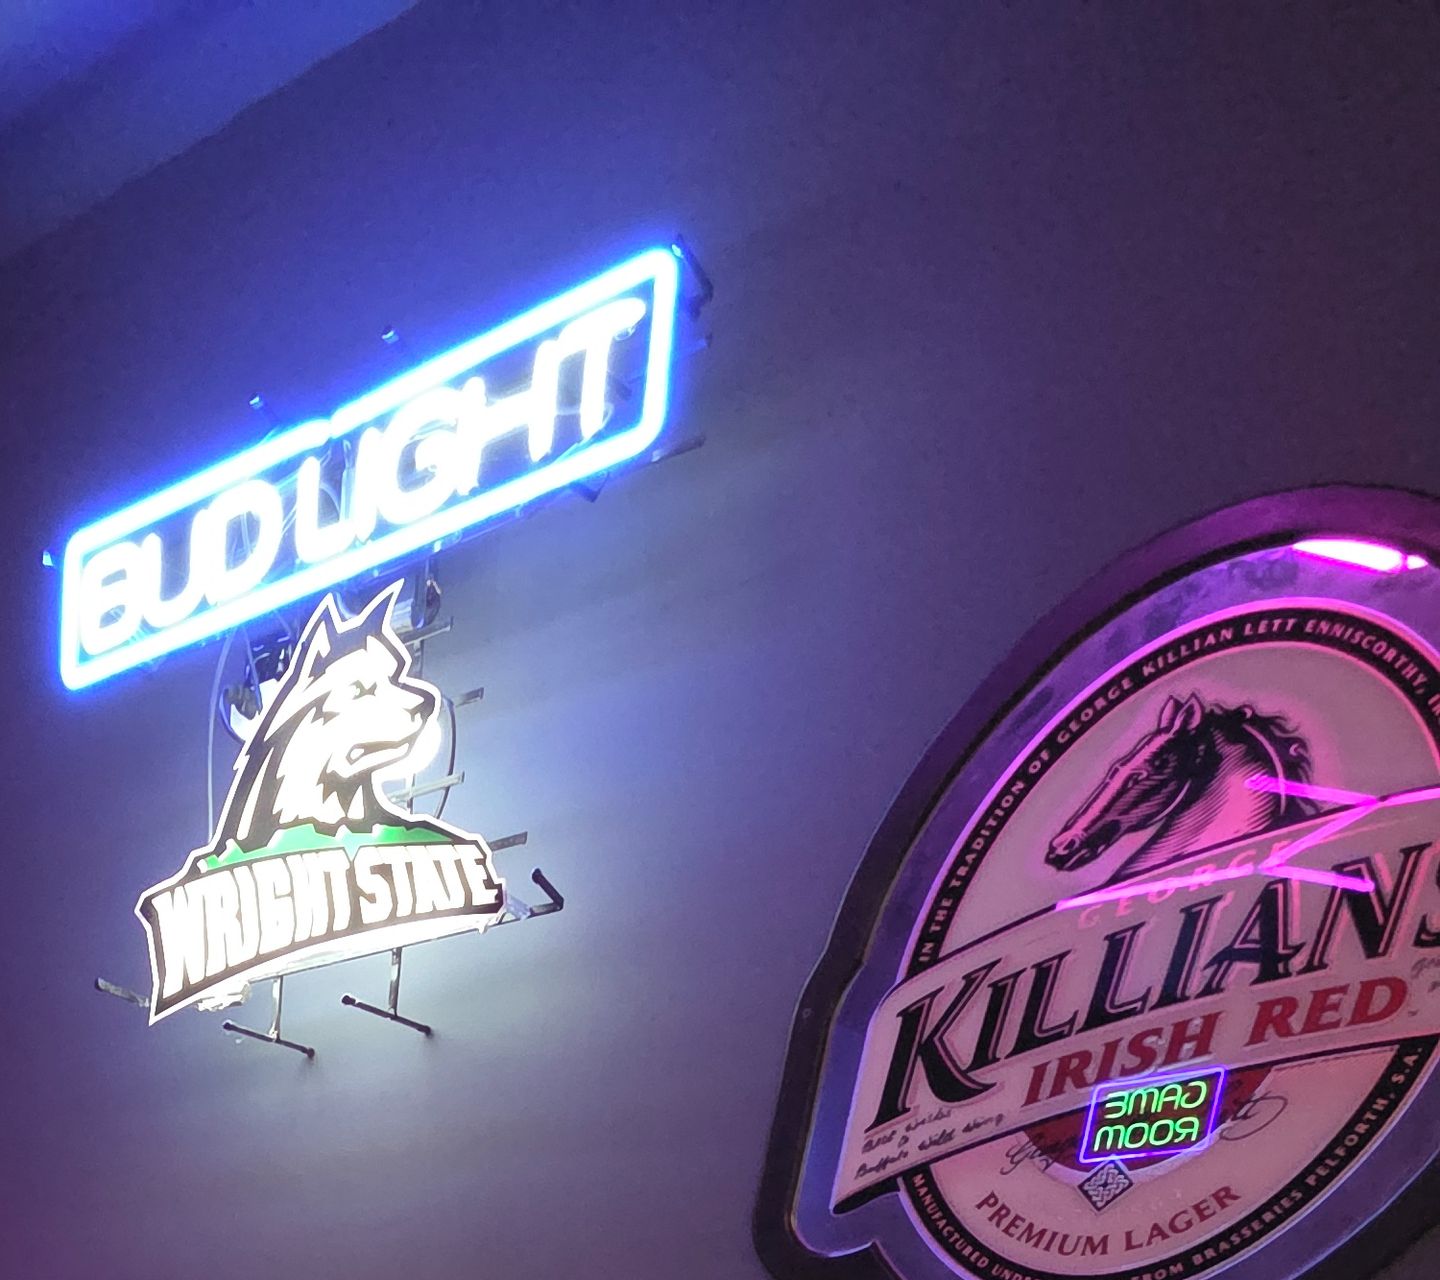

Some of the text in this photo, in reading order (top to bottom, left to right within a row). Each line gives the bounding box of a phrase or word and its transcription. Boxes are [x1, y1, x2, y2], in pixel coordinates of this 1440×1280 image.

[77, 297, 647, 656] BUD LIGHT
[918, 943, 933, 962] IN
[930, 900, 950, 931] THE
[949, 780, 1026, 890] TRADITION
[1028, 749, 1052, 774] OF
[1056, 677, 1133, 744] GEORGE
[1142, 628, 1235, 678] KILLIAN
[1244, 618, 1297, 636] LETT
[151, 843, 499, 1000] WRIGHT STATE
[1021, 1010, 1226, 1108] IRISH
[1244, 976, 1408, 1047] RED
[911, 1173, 988, 1269] MANUFACTURED
[1193, 1189, 1303, 1265] BRASSERIES
[1391, 1047, 1423, 1085] S.A.
[975, 1186, 1242, 1257] PREMIUM LAGER
